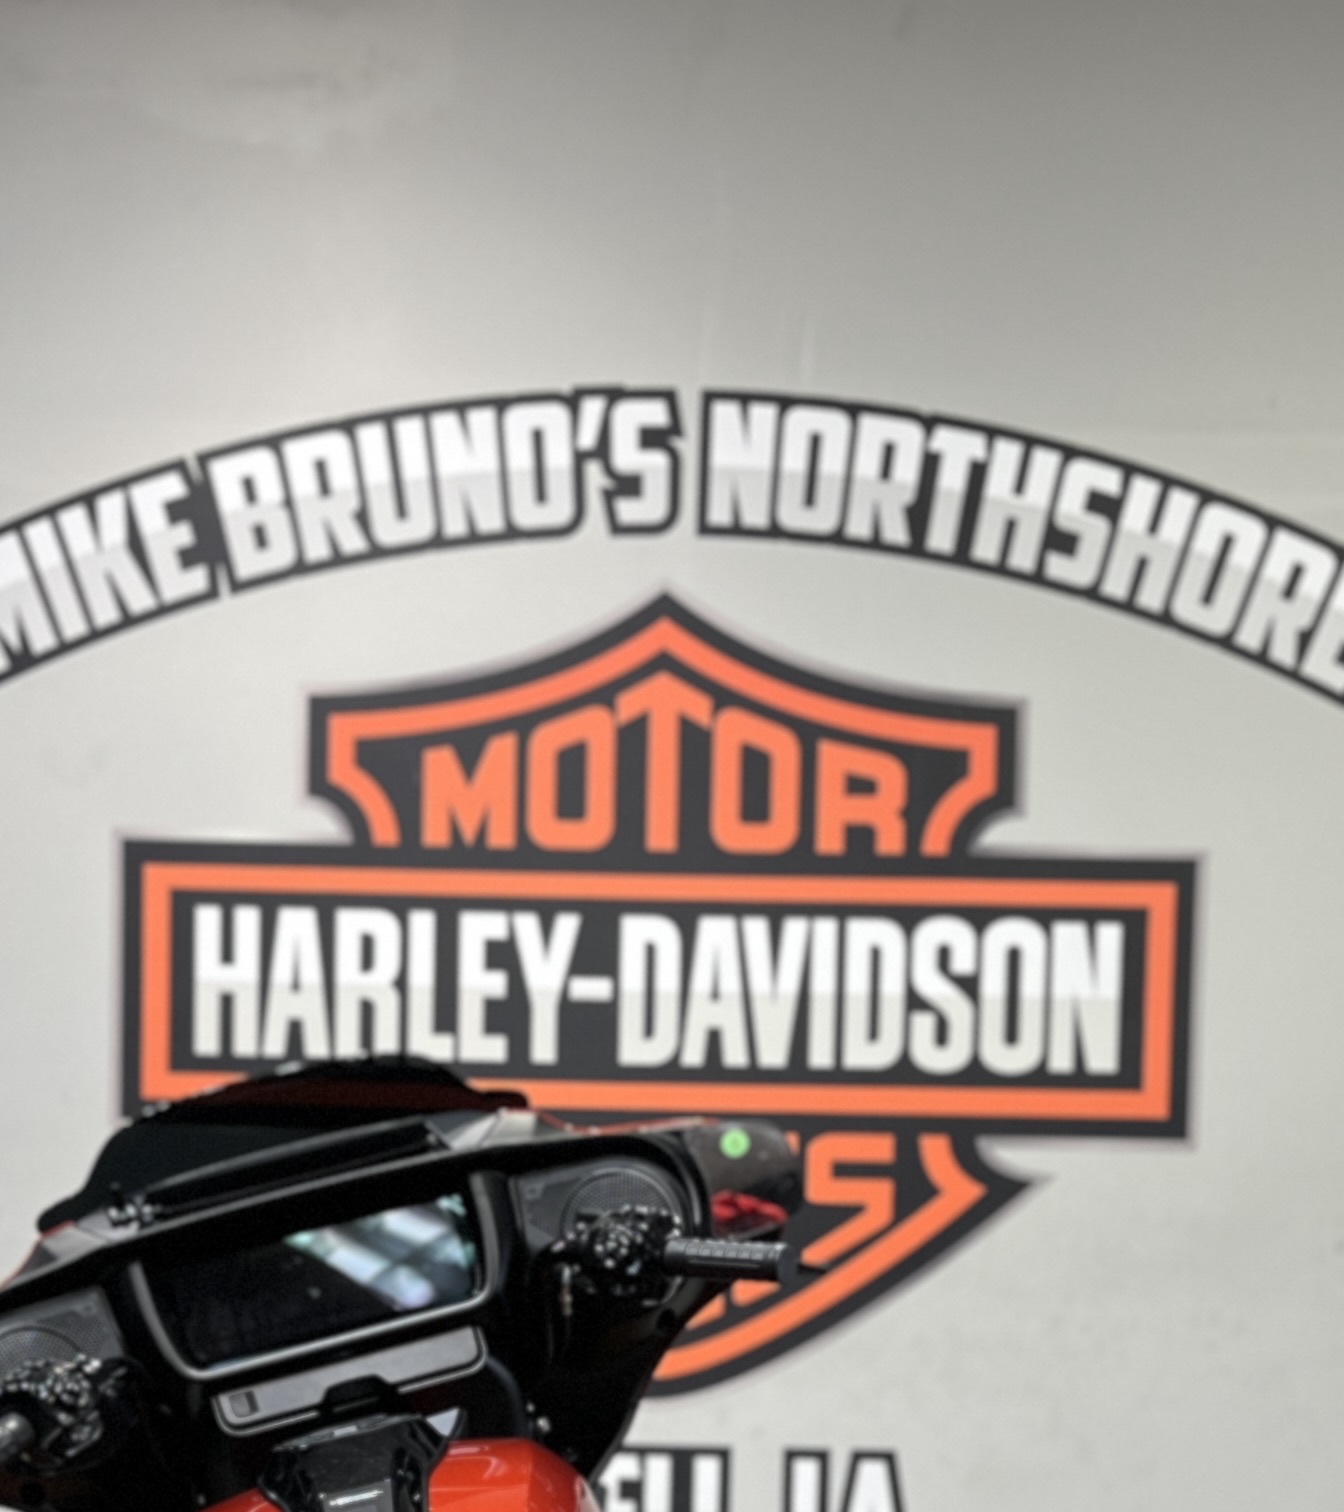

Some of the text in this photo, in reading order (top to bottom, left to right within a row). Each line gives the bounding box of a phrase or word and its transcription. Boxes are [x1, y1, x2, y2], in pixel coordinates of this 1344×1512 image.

[201, 394, 677, 586] BRUNO'S
[419, 669, 909, 858] MOTOR
[191, 903, 1125, 1078] HARLEY-DAVIDSON
